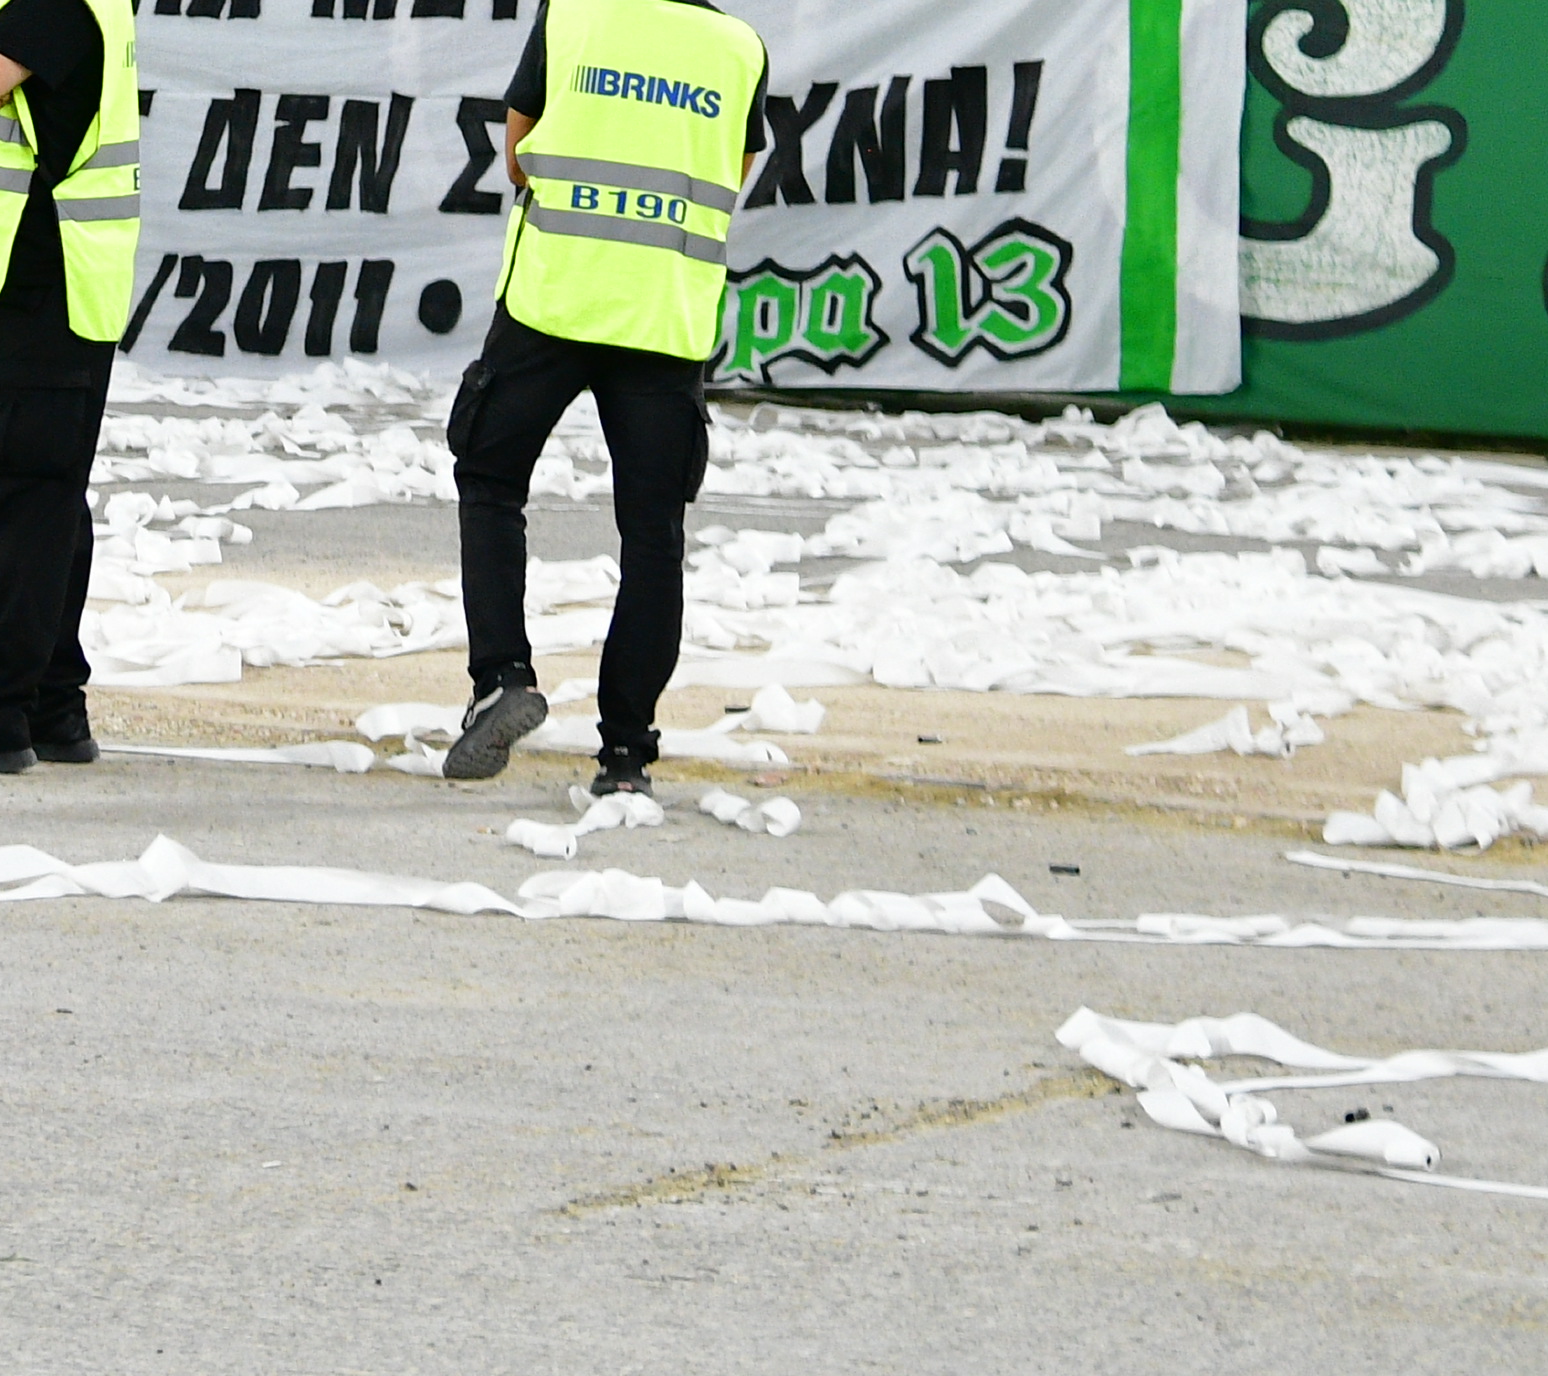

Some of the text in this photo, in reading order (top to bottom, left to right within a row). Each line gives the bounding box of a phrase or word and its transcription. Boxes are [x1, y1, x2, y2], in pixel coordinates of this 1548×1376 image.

[179, 89, 415, 214] ΔΕΝ
[596, 67, 722, 119] BRINKS
[904, 216, 1073, 367] 13
